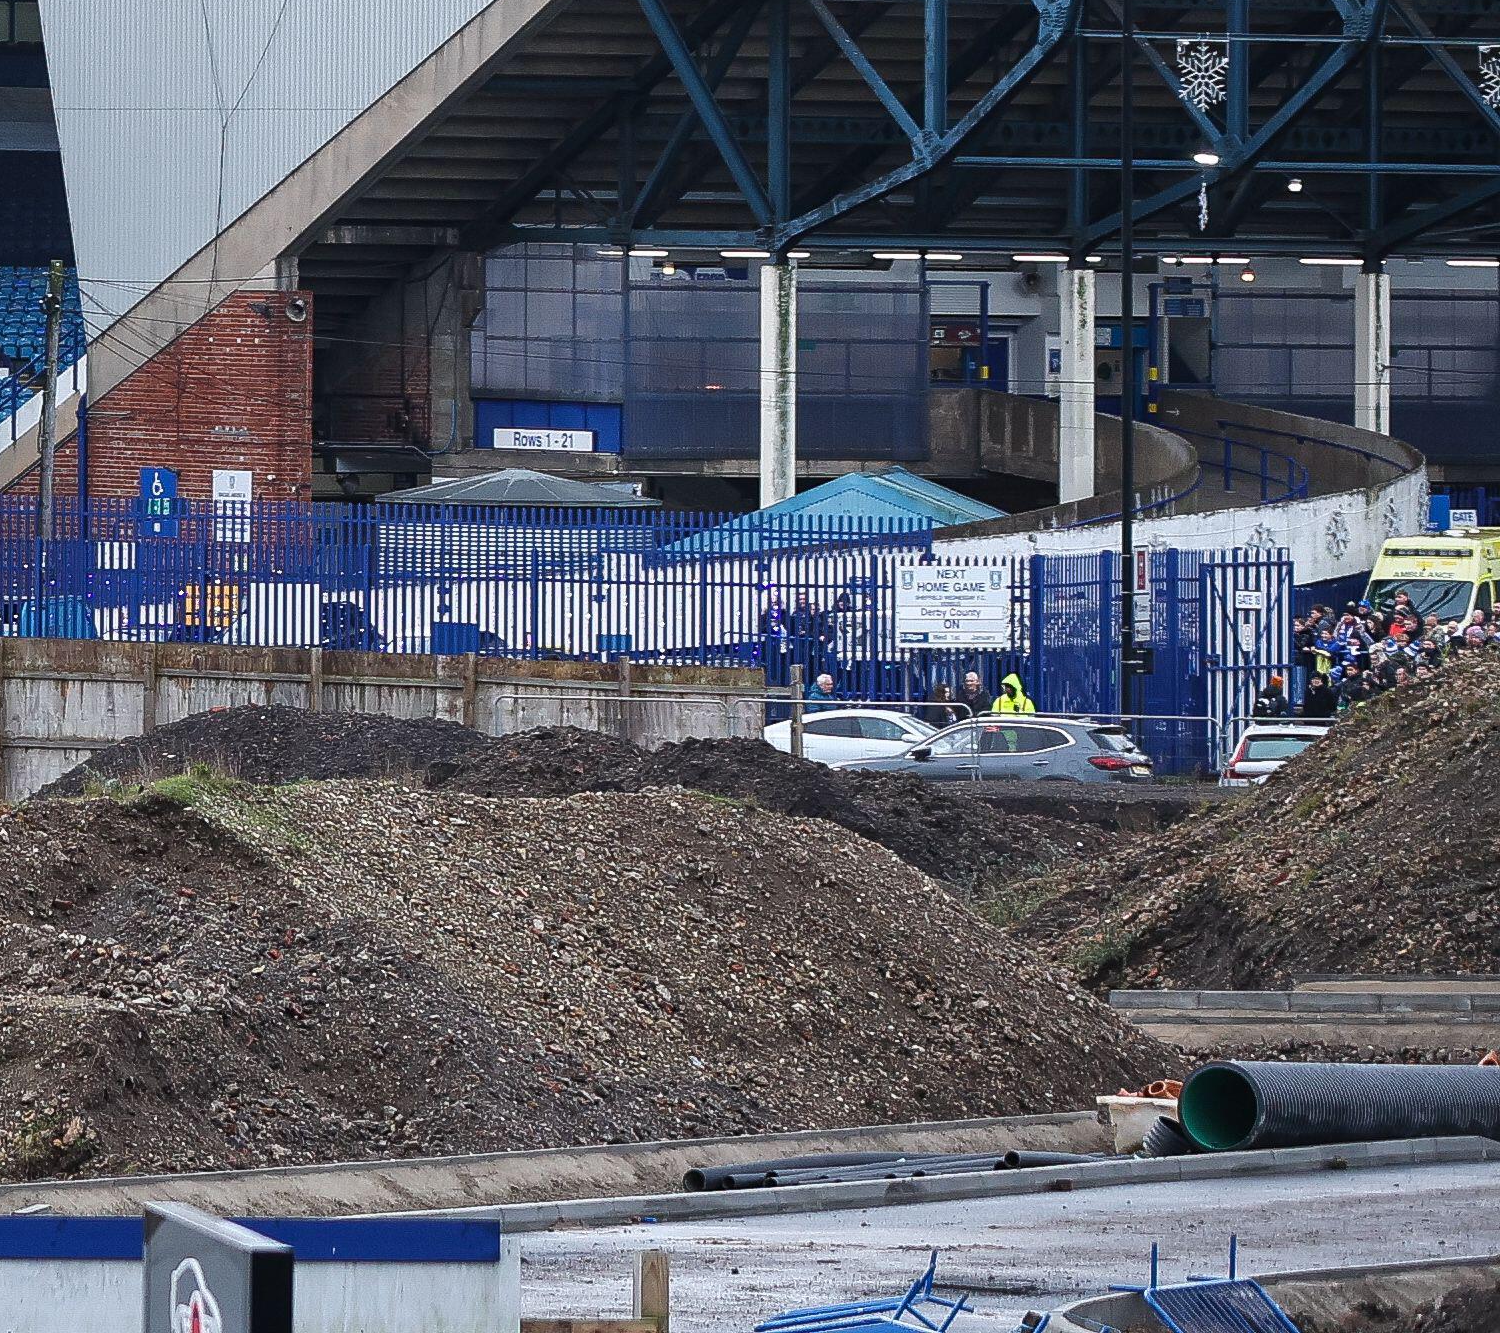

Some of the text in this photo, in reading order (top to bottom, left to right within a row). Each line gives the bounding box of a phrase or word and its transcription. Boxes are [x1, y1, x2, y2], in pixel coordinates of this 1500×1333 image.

[513, 432, 543, 447] Rows
[546, 432, 551, 448] 1
[561, 433, 574, 448] 21
[1452, 511, 1474, 522] GATE
[936, 570, 966, 579] NEXT
[917, 582, 986, 592] HOME GAME
[1236, 594, 1254, 604] GATE
[920, 607, 982, 618] Derby County
[943, 619, 960, 629] ON
